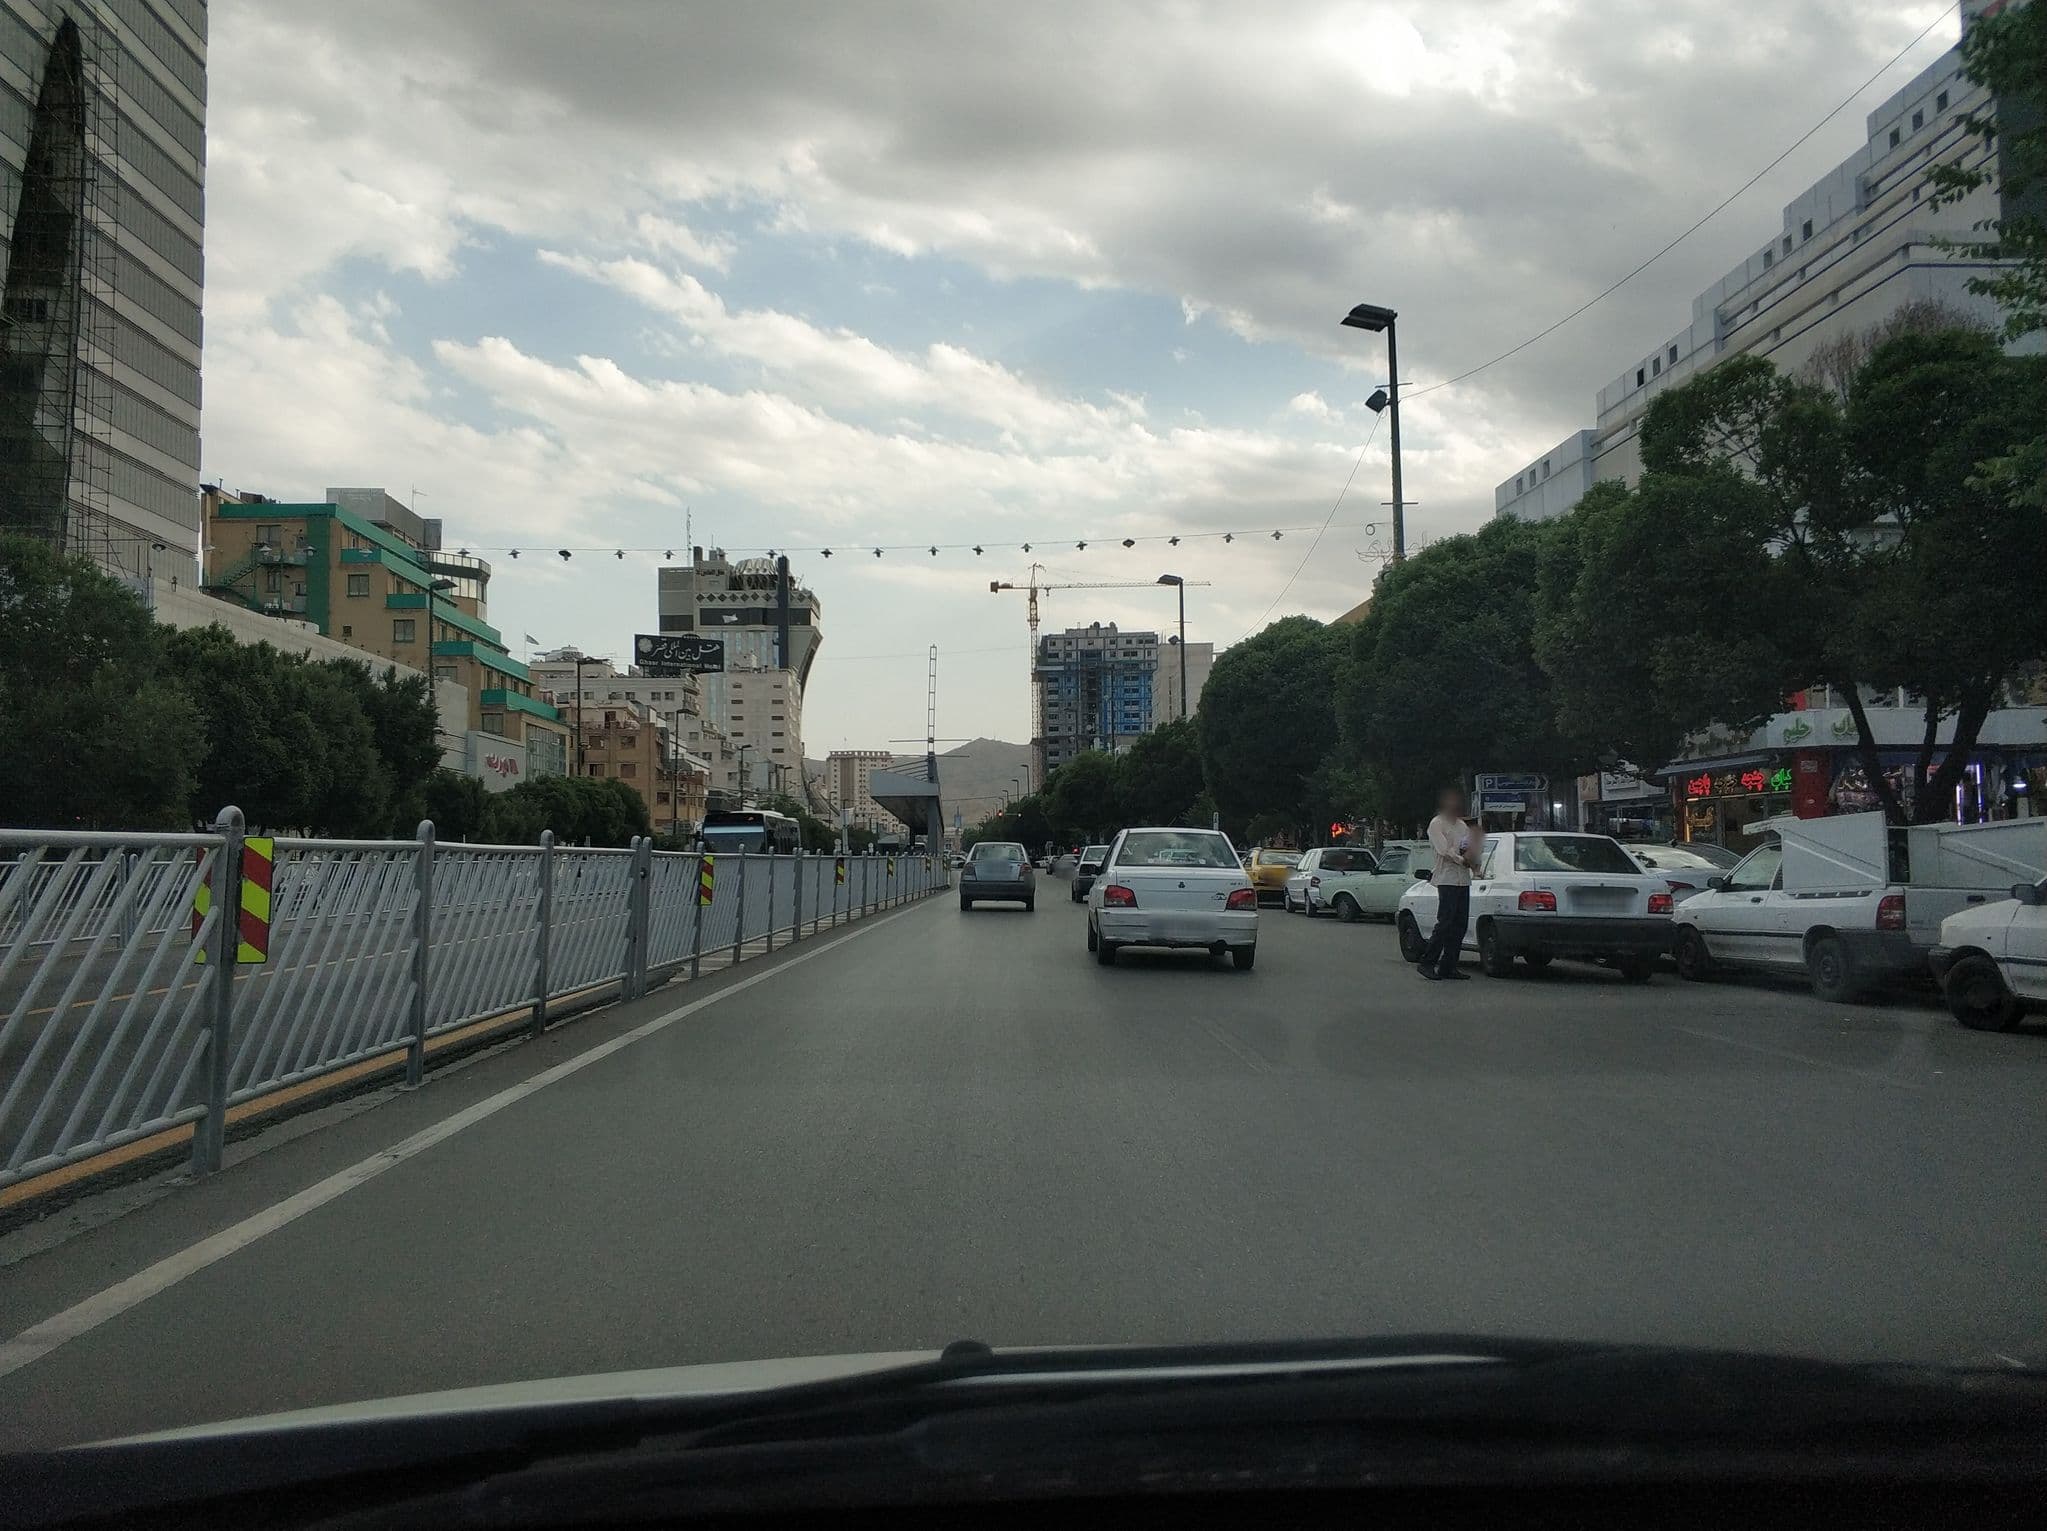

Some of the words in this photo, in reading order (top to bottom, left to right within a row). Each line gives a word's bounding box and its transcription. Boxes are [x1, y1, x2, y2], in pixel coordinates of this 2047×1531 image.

[651, 638, 667, 657] قصر
[678, 648, 692, 661] بین
[692, 643, 720, 660] هتل
